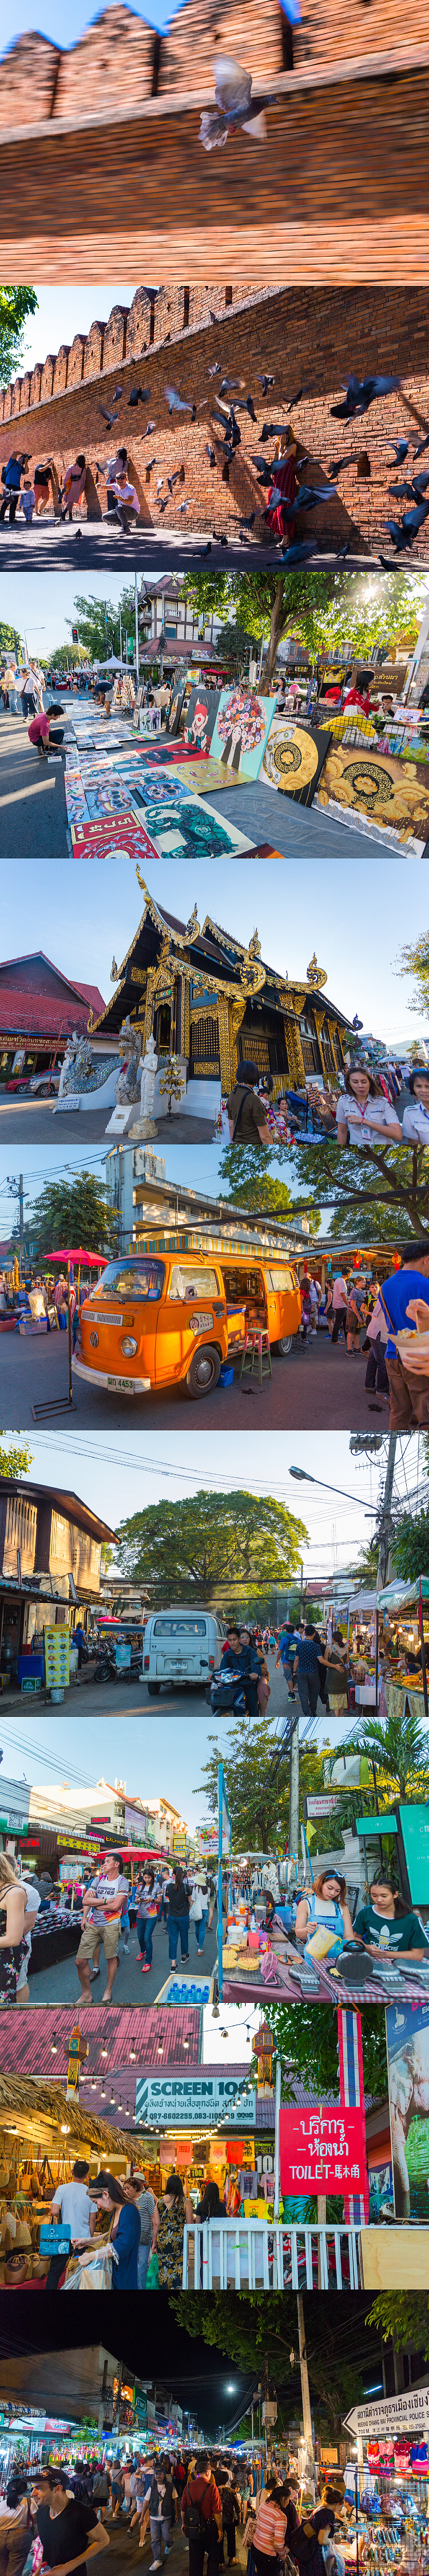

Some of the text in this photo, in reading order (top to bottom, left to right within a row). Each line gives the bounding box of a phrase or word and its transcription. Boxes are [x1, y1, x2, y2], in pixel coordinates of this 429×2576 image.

[118, 1380, 133, 1388] 4453
[106, 1836, 128, 1846] EXCHANGE
[150, 2082, 251, 2096] SCREEN 108
[244, 2098, 253, 2108] ปัก
[387, 2415, 408, 2423] PROVINCIAL
[410, 2411, 425, 2420] POLICE
